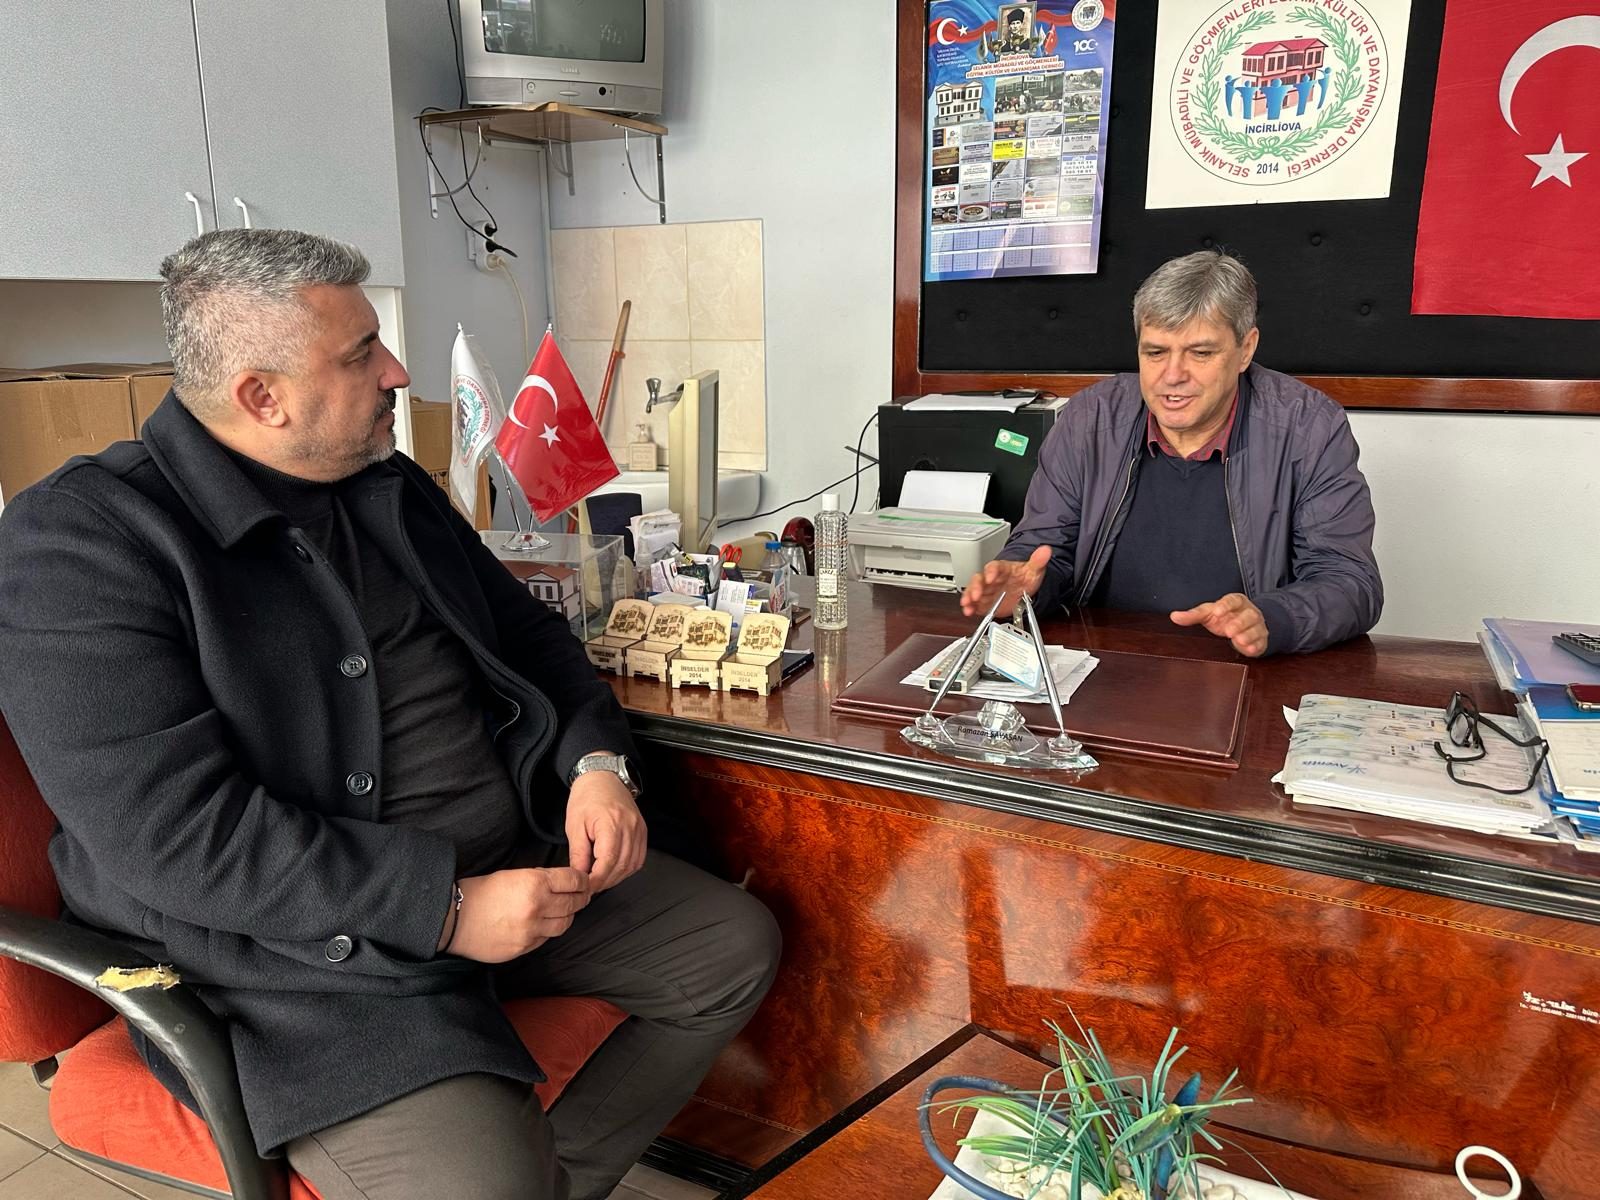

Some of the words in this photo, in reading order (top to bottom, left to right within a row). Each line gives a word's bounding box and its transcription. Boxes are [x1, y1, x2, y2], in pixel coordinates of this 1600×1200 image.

[1363, 35, 1378, 56] VE
[1180, 67, 1194, 85] VE
[1344, 57, 1380, 135] DAYANIŞMA
[1177, 89, 1203, 149] MÜBADİLİ
[1245, 121, 1301, 134] İNCİRLİOVA
[1199, 146, 1250, 178] SELANİK
[1287, 135, 1348, 178] DERNEĞİ
[1256, 162, 1279, 175] 2014
[957, 725, 989, 737] Ramazan
